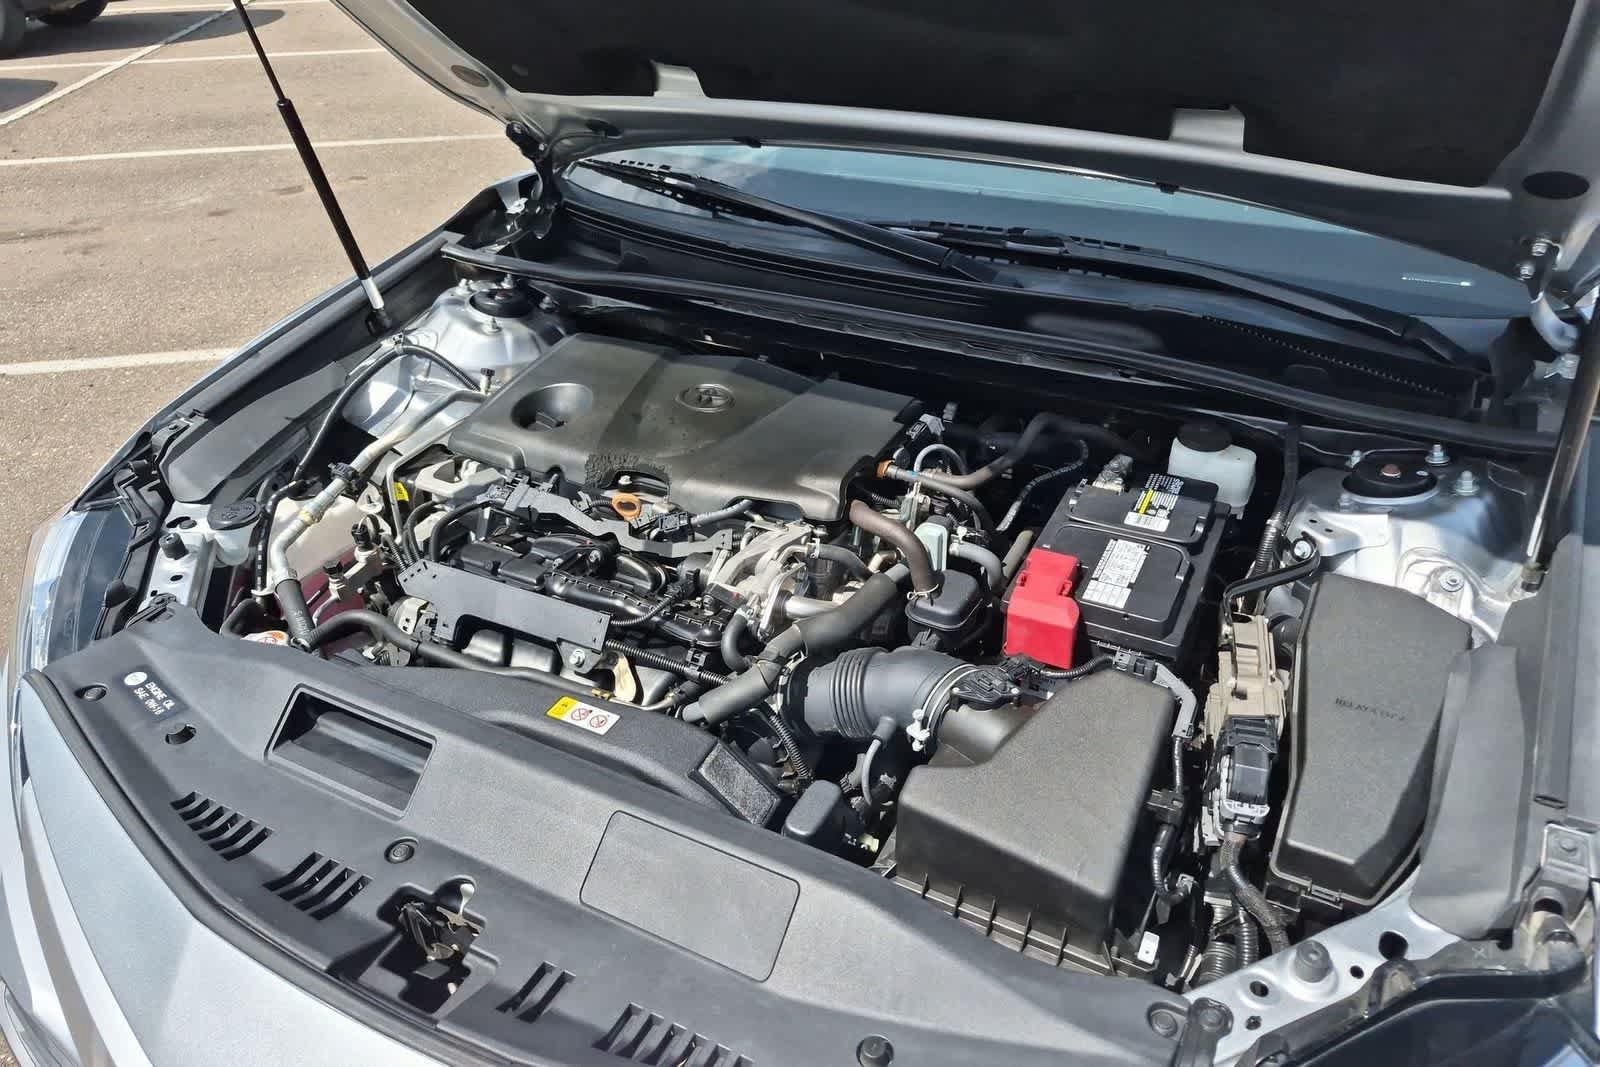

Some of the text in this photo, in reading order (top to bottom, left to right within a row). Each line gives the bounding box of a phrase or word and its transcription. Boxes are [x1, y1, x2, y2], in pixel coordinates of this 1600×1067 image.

[133, 688, 149, 700] SAE
[145, 682, 175, 710] ENGINE OIL
